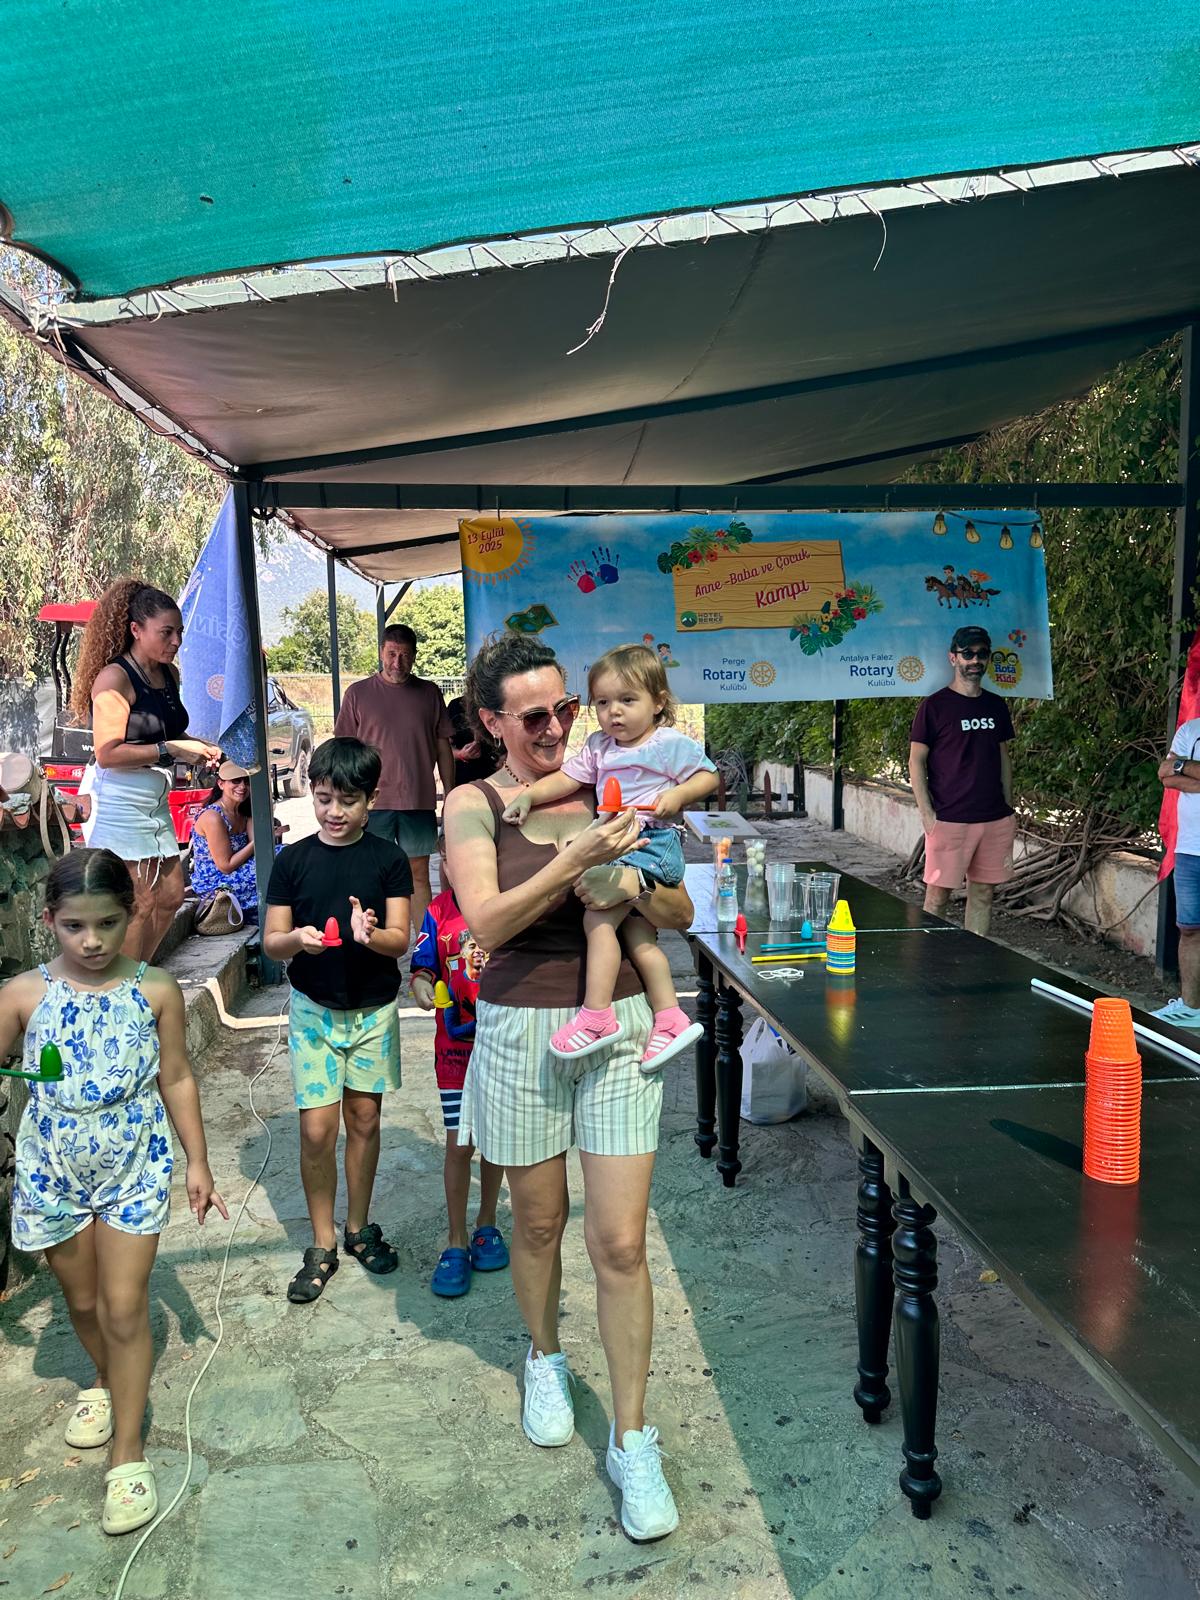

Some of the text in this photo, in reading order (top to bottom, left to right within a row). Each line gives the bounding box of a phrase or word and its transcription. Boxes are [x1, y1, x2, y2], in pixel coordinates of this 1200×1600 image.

[467, 527, 505, 545] 13 Eylül
[479, 540, 503, 554] 2025
[761, 562, 774, 573] ve
[775, 548, 811, 572] Çocuk
[756, 580, 810, 608] Kampı
[722, 658, 746, 666] Perge
[839, 653, 893, 663] Antalya Falez
[850, 664, 894, 678] Rotary
[994, 663, 1016, 673] Rota
[702, 668, 746, 682] Rotary
[995, 674, 1017, 684] Kids
[720, 683, 747, 692] Kulübü
[868, 679, 896, 687] Kulübü
[961, 718, 995, 731] BOSS
